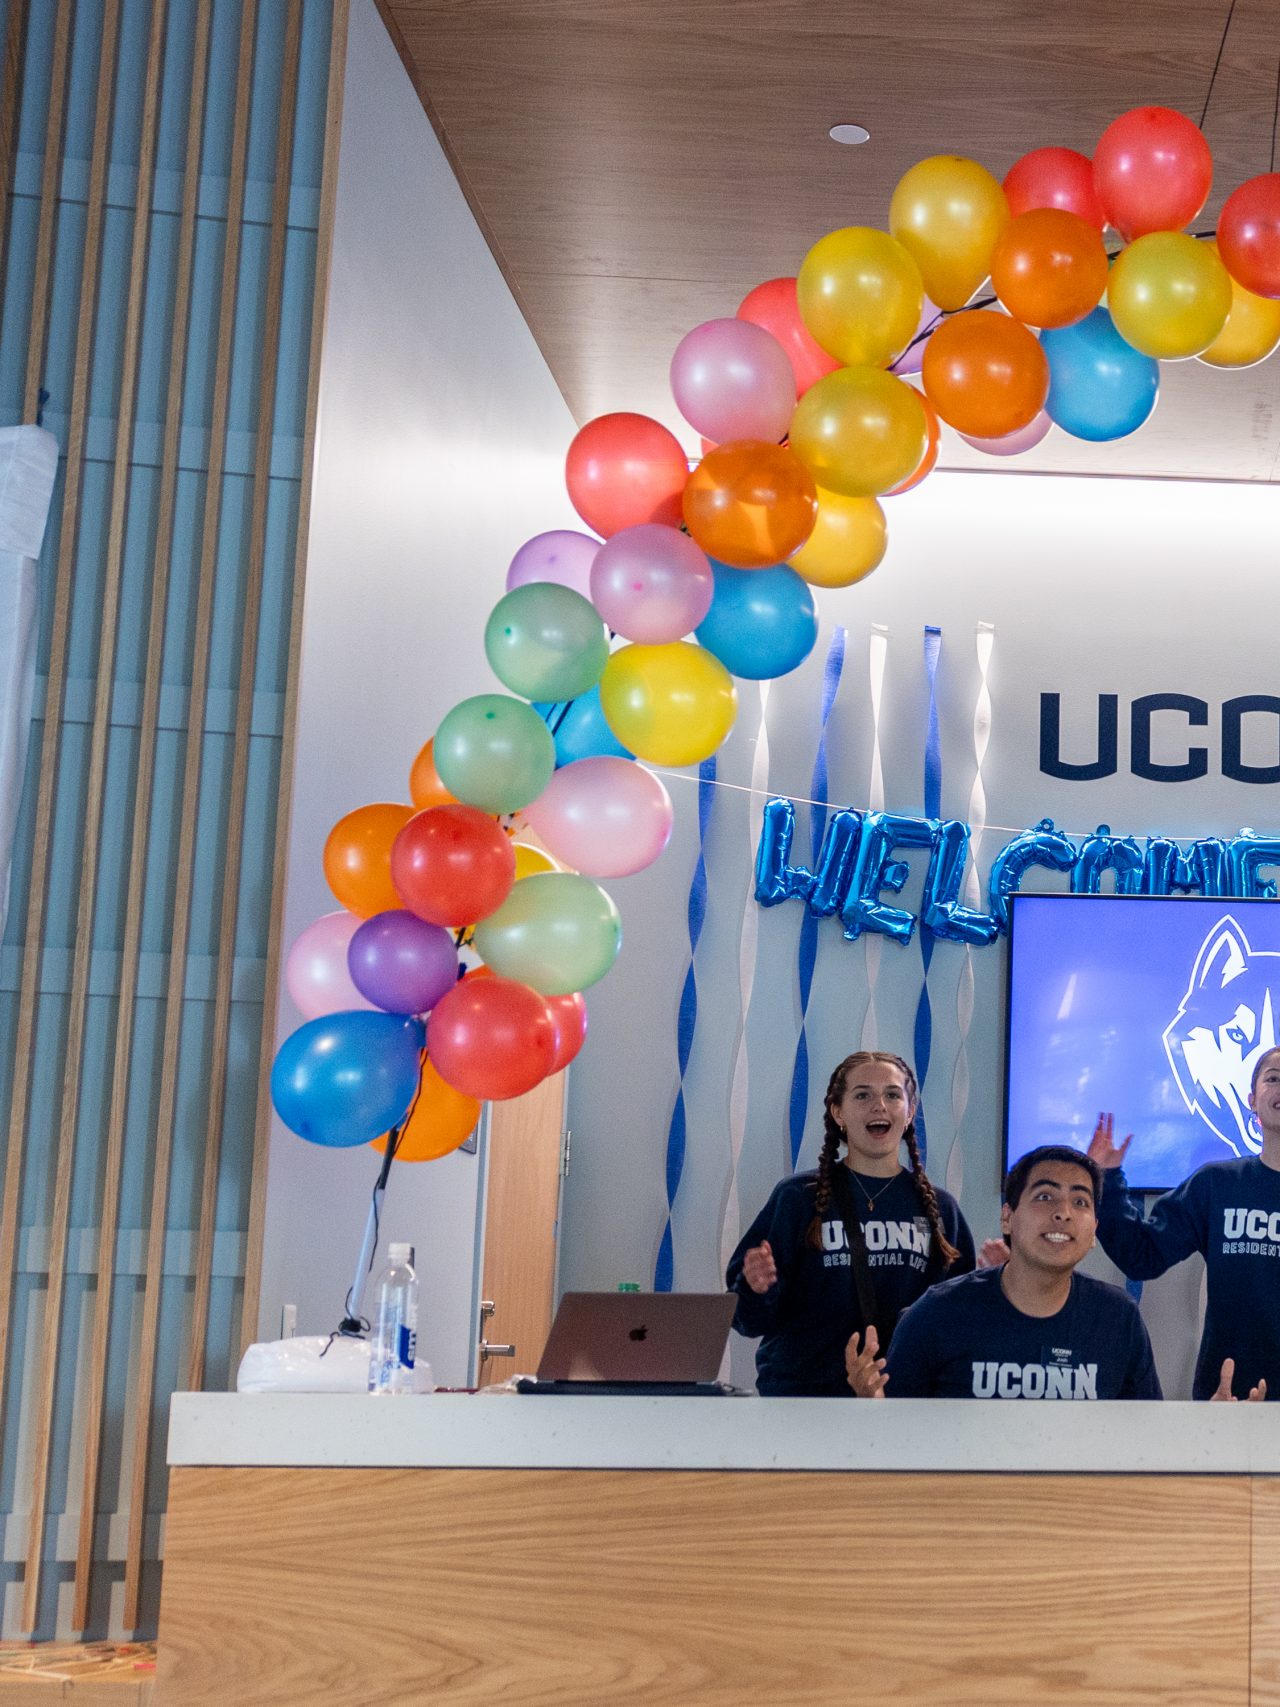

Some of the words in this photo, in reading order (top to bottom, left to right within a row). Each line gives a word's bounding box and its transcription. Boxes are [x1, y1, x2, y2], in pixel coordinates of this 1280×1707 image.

[821, 1220, 931, 1258] UONN
[823, 1253, 905, 1267] RESINTIAL
[971, 1361, 1098, 1400] UCONN
